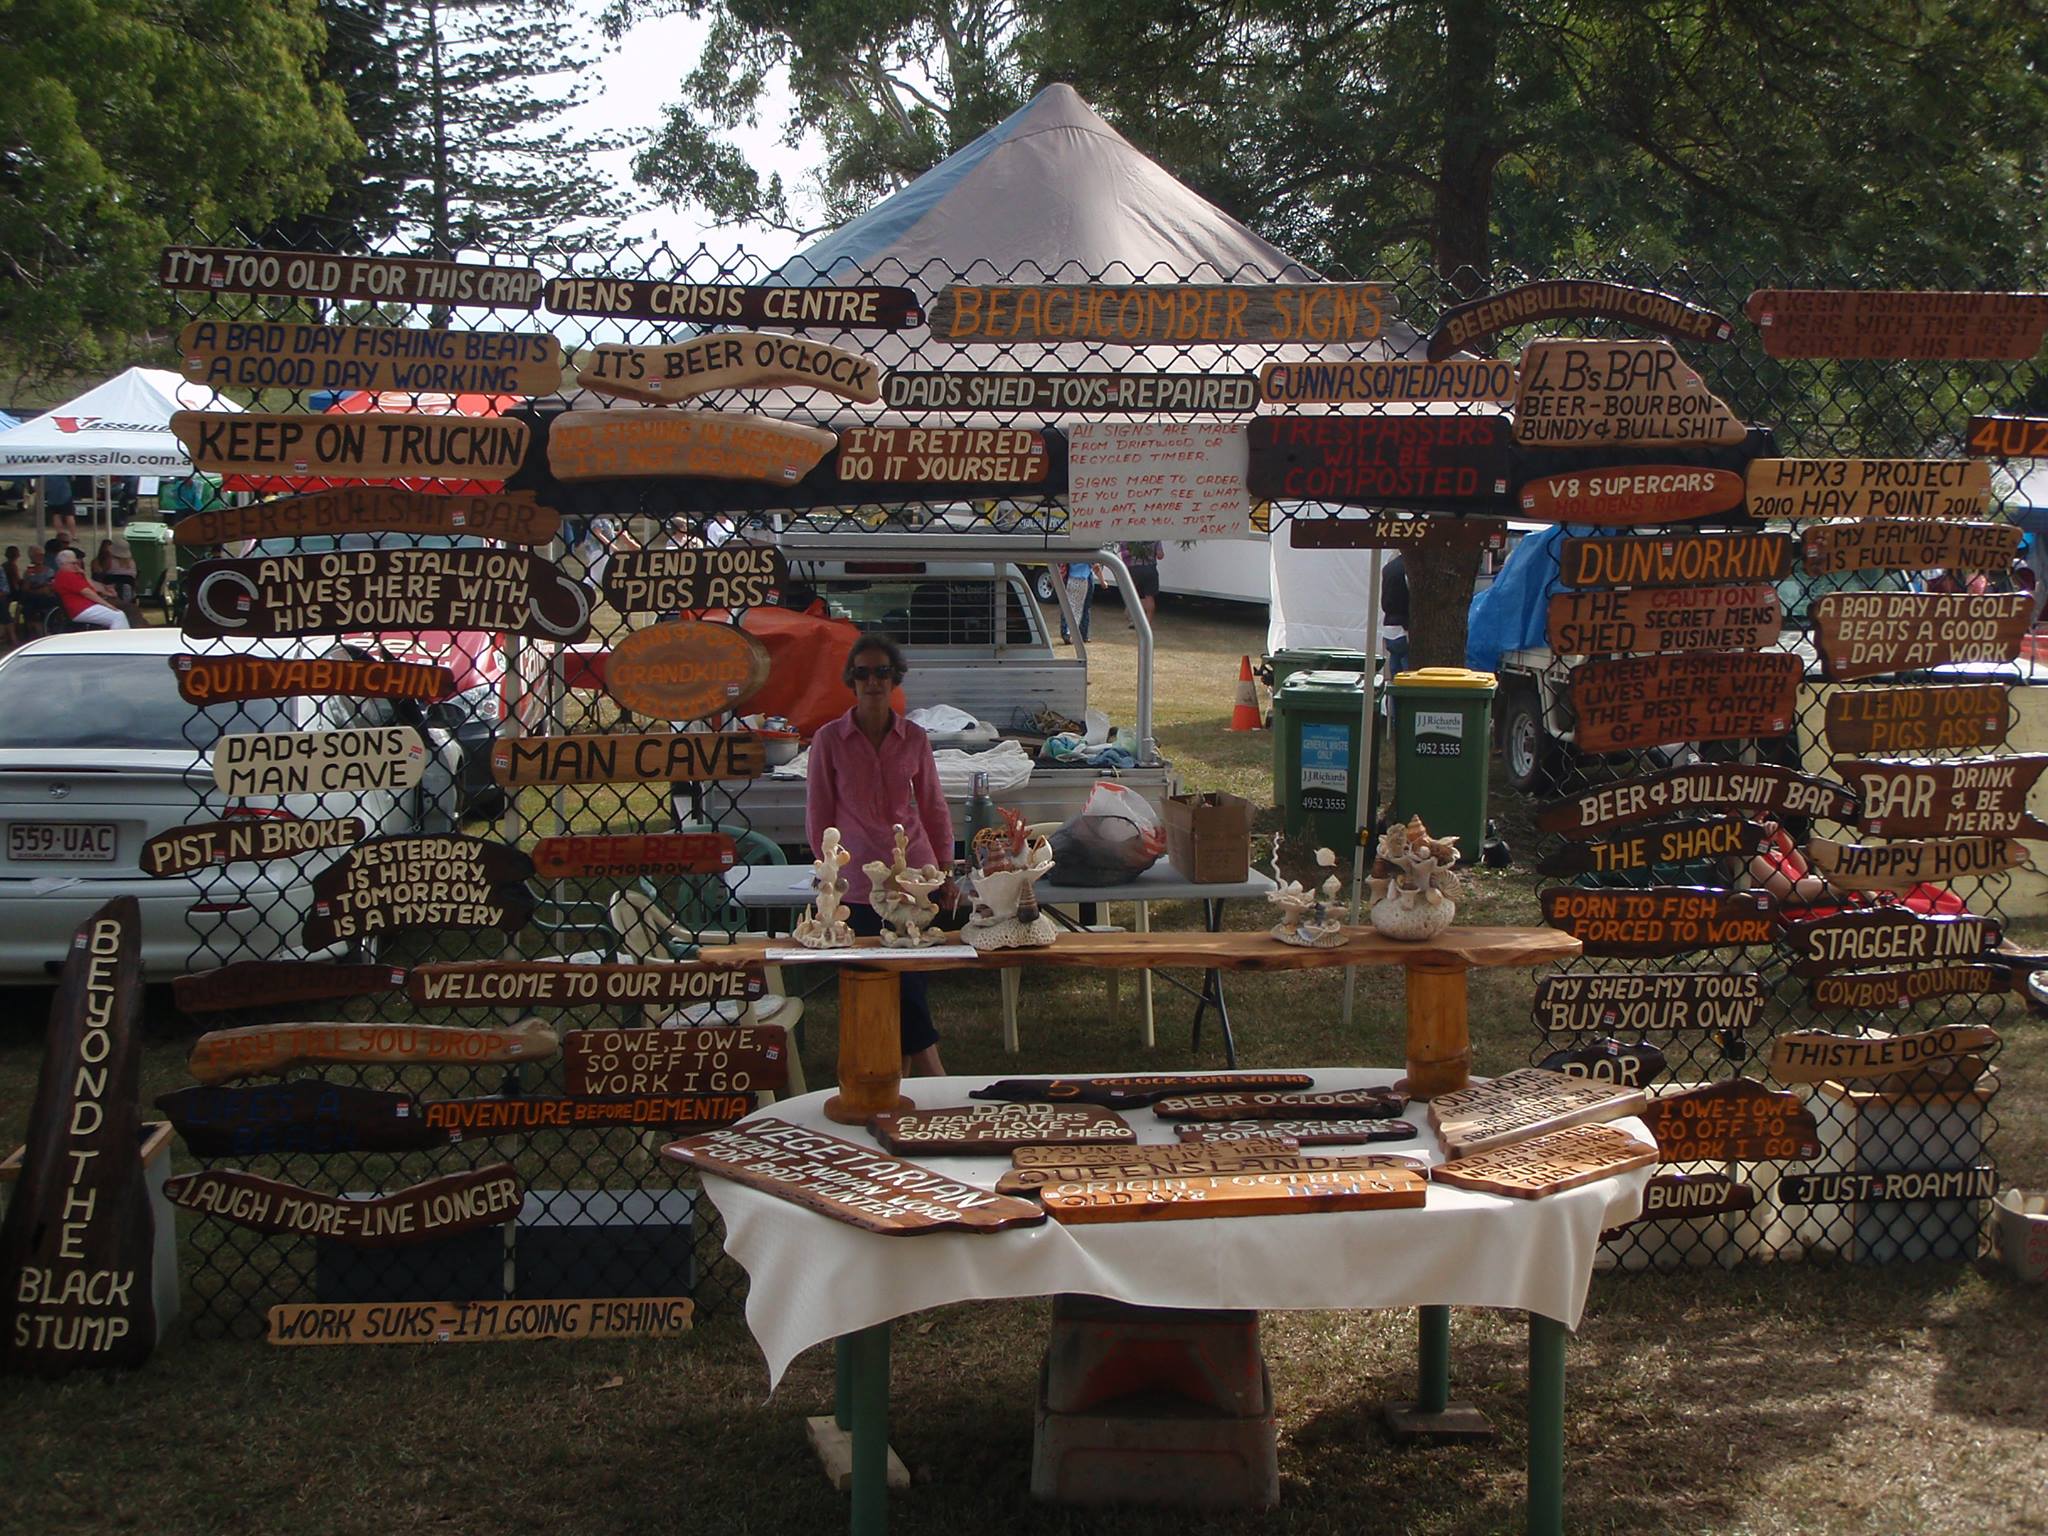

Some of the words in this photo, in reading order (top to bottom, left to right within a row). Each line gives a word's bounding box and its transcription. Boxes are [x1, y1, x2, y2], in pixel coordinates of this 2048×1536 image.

[165, 250, 213, 284] I'M
[222, 254, 280, 287] TOO
[287, 260, 341, 292] OLD
[351, 263, 404, 296] FOR
[414, 268, 475, 299] THIS
[477, 272, 541, 303] CRAP
[552, 279, 634, 312] MENS
[650, 285, 746, 316] CRISIS
[764, 289, 879, 323] CENTRE
[949, 287, 1249, 340] BEACHCOMBER
[1271, 285, 1382, 341] SIGNS
[192, 322, 217, 351] A
[225, 323, 284, 353] BAD
[302, 328, 346, 355] DAY
[354, 329, 455, 359] FISHING
[465, 334, 548, 363] BEATS
[207, 356, 231, 383] A
[239, 358, 314, 385] GOOD
[322, 361, 379, 388] DAY
[392, 364, 519, 392] WORKING
[592, 348, 645, 380] IT'S
[664, 340, 743, 379] BEER
[755, 340, 871, 390] O'CLOCK
[201, 421, 302, 462] KEEP
[316, 424, 366, 463] ON
[377, 424, 524, 465] TRUCKIN
[848, 430, 895, 453] I'M
[908, 431, 1032, 454] RETIRED
[1070, 442, 1107, 451] FROM
[1116, 439, 1194, 449] DRIFTWOOD
[1205, 438, 1223, 448] OR
[1104, 425, 1153, 437] SIGNS
[1163, 424, 1188, 434] ARE
[1198, 424, 1239, 434] MADE
[1267, 418, 1495, 446] TRESPASSERS
[5, 452, 191, 465] www.vassallo.com.a
[841, 456, 873, 480] DO
[884, 457, 907, 480] IT
[917, 457, 1040, 481] YOURSELF
[1070, 454, 1141, 464] RECYCLED
[1323, 448, 1387, 466] WILL
[1399, 448, 1430, 465] BE
[1075, 477, 1117, 488] SIGNS
[1127, 475, 1164, 485] MADE
[1170, 476, 1187, 484] TO
[1283, 467, 1478, 496] COMPOSTED
[1549, 479, 1579, 498] V8
[1589, 472, 1716, 496] SUPERCARS
[1776, 461, 1847, 486] HPX3
[1860, 461, 1970, 486] PROJECT
[1753, 497, 1794, 516] 2010
[1800, 490, 1858, 515] HAY
[1868, 490, 1940, 515] POINT
[1943, 498, 1983, 516] 2014
[1375, 522, 1428, 538] KEYS
[259, 556, 302, 585] AN
[321, 552, 375, 578] OLD
[389, 551, 530, 580] STALLION
[612, 554, 630, 577] I
[634, 552, 697, 576] LEND
[702, 550, 774, 575] TOOLS
[1576, 538, 1784, 584] DUNWORKIN
[266, 579, 353, 609] LIVES
[366, 575, 440, 599] HERE
[459, 580, 530, 604] WITH
[1568, 593, 1630, 621] THE
[1651, 588, 1758, 609] CAUTION
[273, 606, 322, 632] HIS
[336, 599, 434, 626] YOUNG
[449, 601, 531, 630] FILLY
[1644, 609, 1716, 629] SECRET
[1725, 607, 1774, 626] MENS
[1559, 622, 1636, 651] SHED
[1660, 628, 1758, 649] BUSINESS
[185, 661, 443, 698] QUITYABITCHIN
[228, 737, 293, 763] DAD
[323, 730, 403, 757] SONS
[509, 740, 616, 781] MAN
[634, 735, 750, 776] CAVE
[1416, 743, 1436, 754] 4952
[1439, 743, 1460, 755] 3555
[229, 765, 307, 795] MAN
[321, 760, 408, 789] CAVE
[1302, 797, 1323, 809] 4952
[1325, 798, 1346, 810] 3555
[152, 833, 217, 872] PIST
[230, 827, 252, 857] N
[260, 818, 355, 853] BROKE
[350, 839, 483, 868] YESTERDAY
[1591, 838, 1645, 871] THE
[1660, 822, 1743, 861] SHACK
[1834, 848, 1921, 877] HAPPY
[1934, 839, 2008, 874] HOUR
[347, 867, 369, 888] IS
[337, 884, 491, 914] TOMORROW
[1553, 897, 1616, 919] BORN
[1625, 898, 1655, 918] TO
[1662, 897, 1719, 920] FISH
[333, 915, 356, 937] IS
[365, 910, 385, 931] A
[393, 904, 504, 926] MYSTERY
[1574, 920, 1663, 941] FORCED
[1670, 921, 1698, 941] TO
[1708, 921, 1770, 942] WORK
[1808, 924, 1926, 961] STAGGER
[1933, 922, 1982, 955] INN
[424, 972, 556, 999] WELCOME
[563, 972, 598, 996] TO
[606, 972, 659, 996] OUR
[668, 971, 746, 996] HOME
[70, 918, 121, 1137] BEYOND
[1784, 1042, 1896, 1067] THISTLE
[1902, 1032, 1956, 1061] DOO
[426, 1101, 573, 1128] ADVENTURE
[632, 1097, 747, 1122] DEMENTIA
[972, 1104, 1054, 1116] DAD
[1166, 1095, 1247, 1111] BEER
[1254, 1091, 1378, 1106] O'CLOCK
[745, 1119, 1000, 1211] VEGETARIAN
[177, 1173, 269, 1225] LAUGH
[423, 1178, 521, 1229] LONGER
[1648, 1182, 1731, 1209] BUNDY
[1800, 1175, 1874, 1201] JUST
[1884, 1171, 1994, 1199] ROAMIN
[59, 1150, 99, 1259] THE
[18, 1266, 135, 1307] BLACK
[16, 1313, 129, 1352] STUMP
[277, 1308, 355, 1340] WORK
[505, 1303, 578, 1335] GOING
[589, 1300, 684, 1333] FISHING
